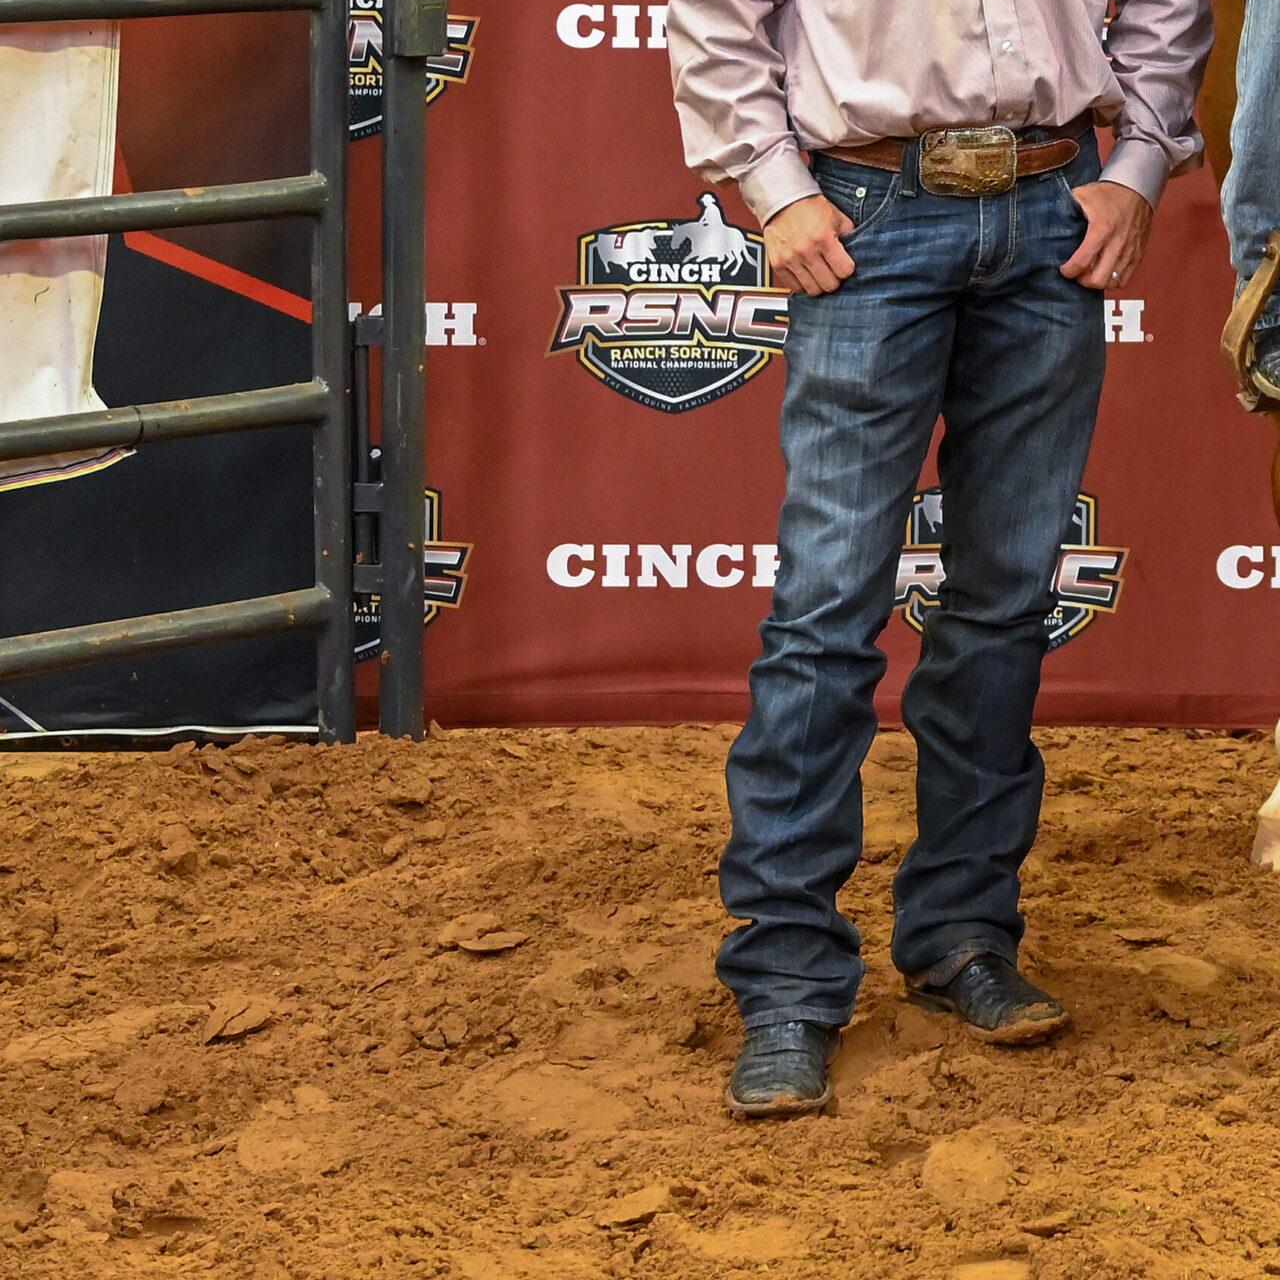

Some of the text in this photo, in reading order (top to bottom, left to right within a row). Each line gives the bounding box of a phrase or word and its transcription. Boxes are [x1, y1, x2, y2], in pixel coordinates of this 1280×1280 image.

[629, 263, 721, 283] CINCH
[560, 293, 789, 344] RSNC
[611, 346, 738, 361] RANCH SORTING
[611, 359, 738, 370] NATIONAL CHAMPIONSHIPS
